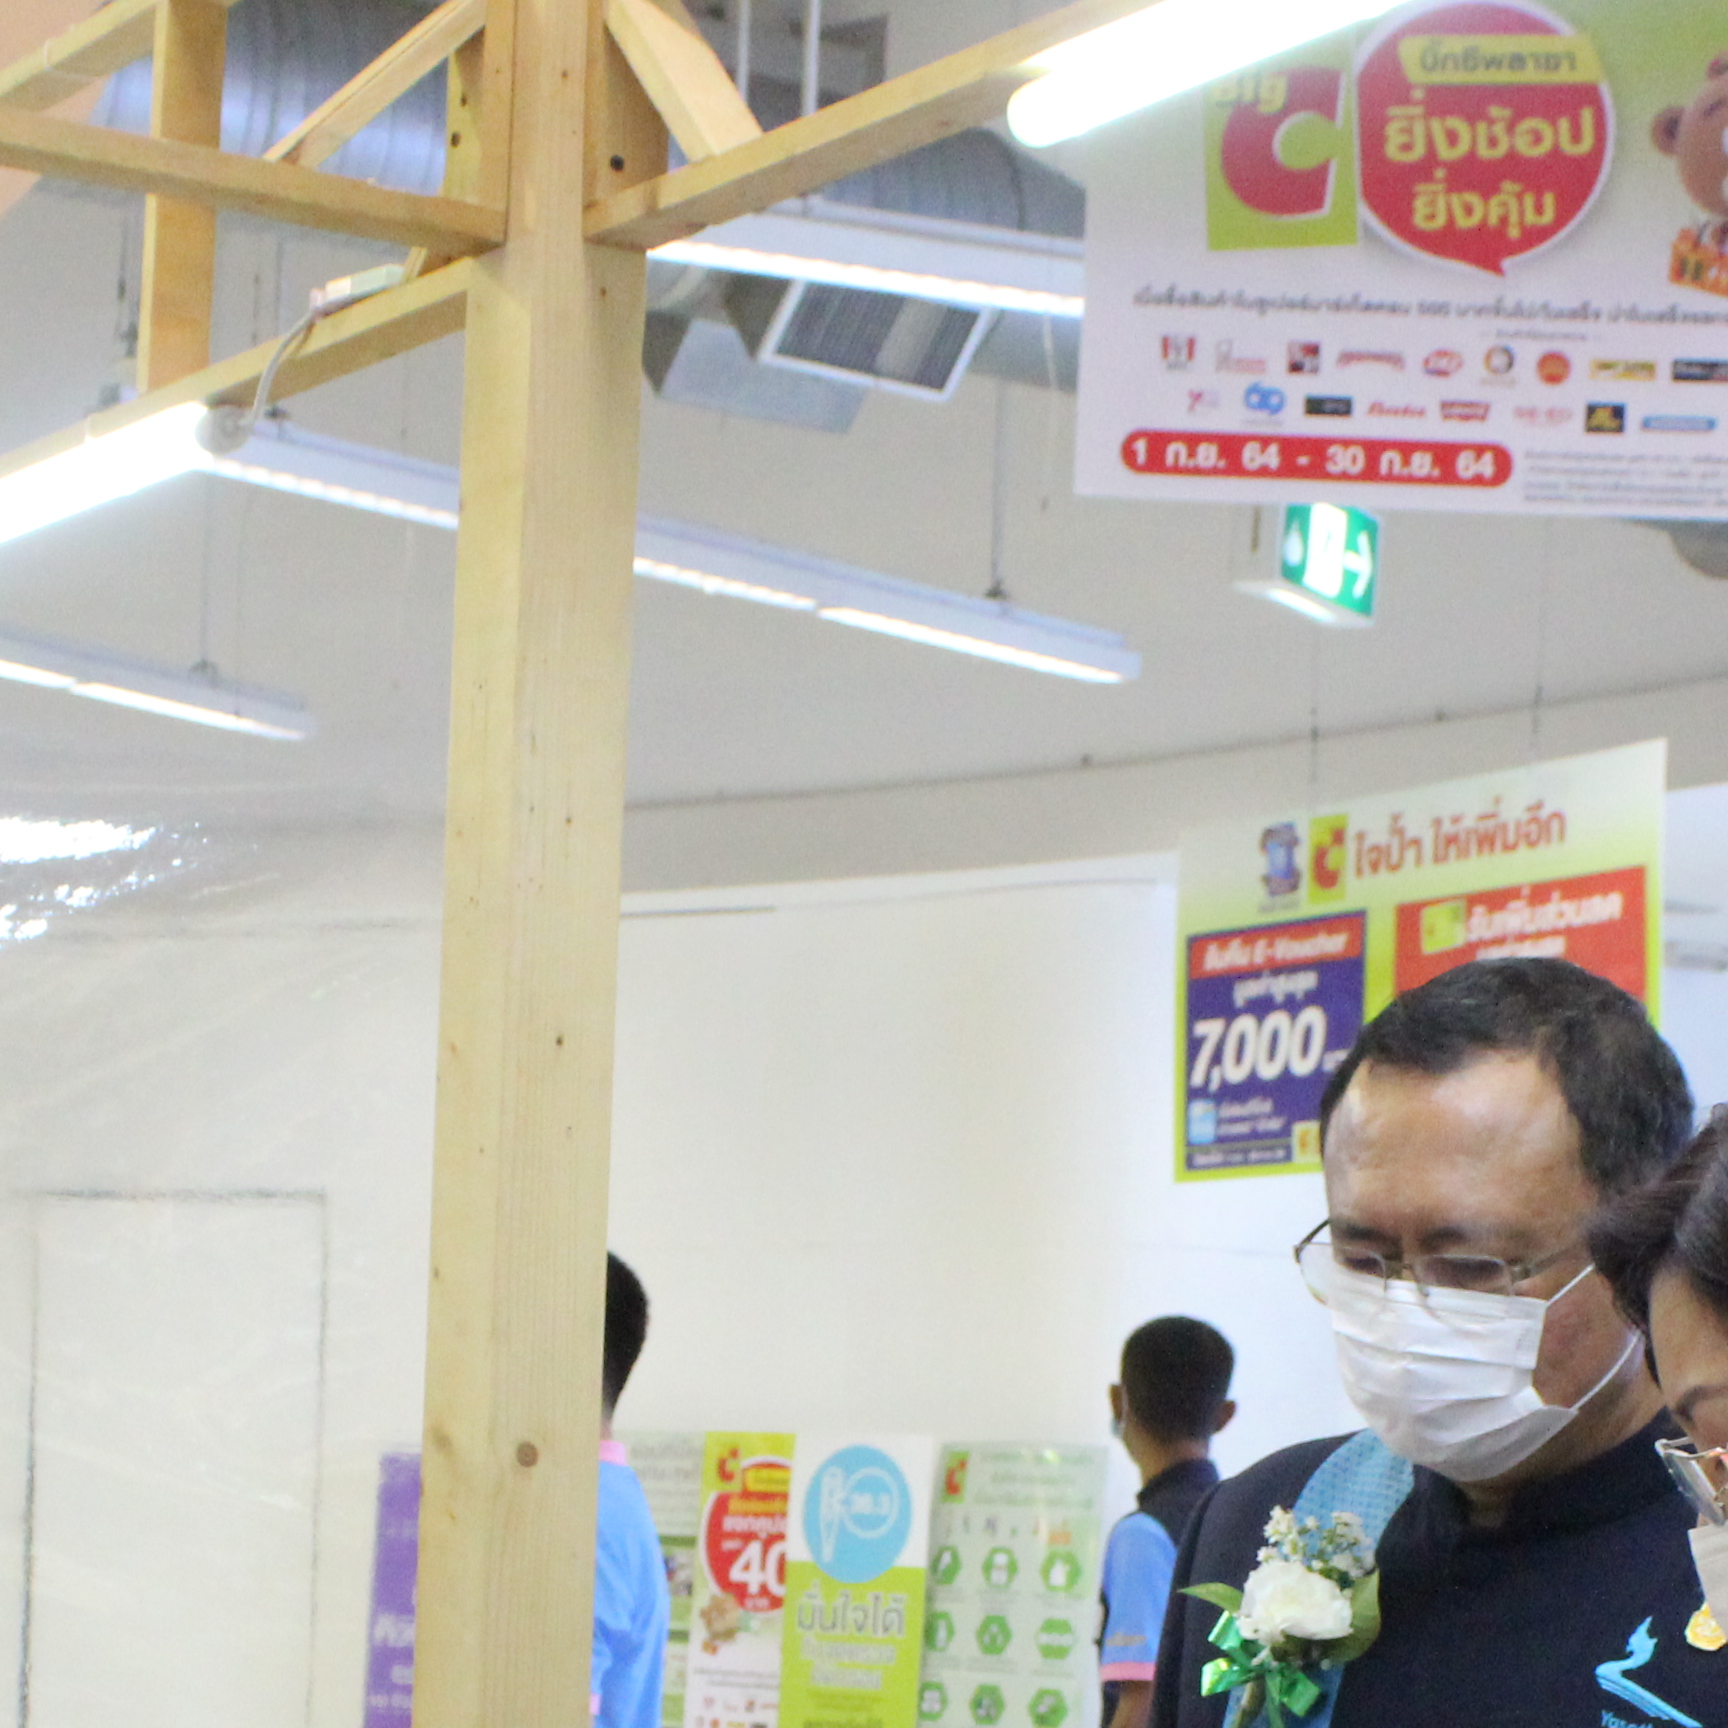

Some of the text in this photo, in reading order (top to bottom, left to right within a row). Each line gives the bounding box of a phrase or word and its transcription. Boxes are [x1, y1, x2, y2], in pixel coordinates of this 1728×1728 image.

[1384, 86, 1596, 162] ยิ่งช้อป
[1412, 168, 1557, 239] ยิ่งคุ้ม
[1132, 438, 1147, 464] 1
[1165, 442, 1225, 469] ก.ย.
[1242, 441, 1280, 471] 64
[1325, 445, 1364, 474] 30
[1380, 449, 1439, 477] ก.ย.
[1455, 451, 1494, 479] 64
[1189, 1006, 1327, 1093] 7,000
